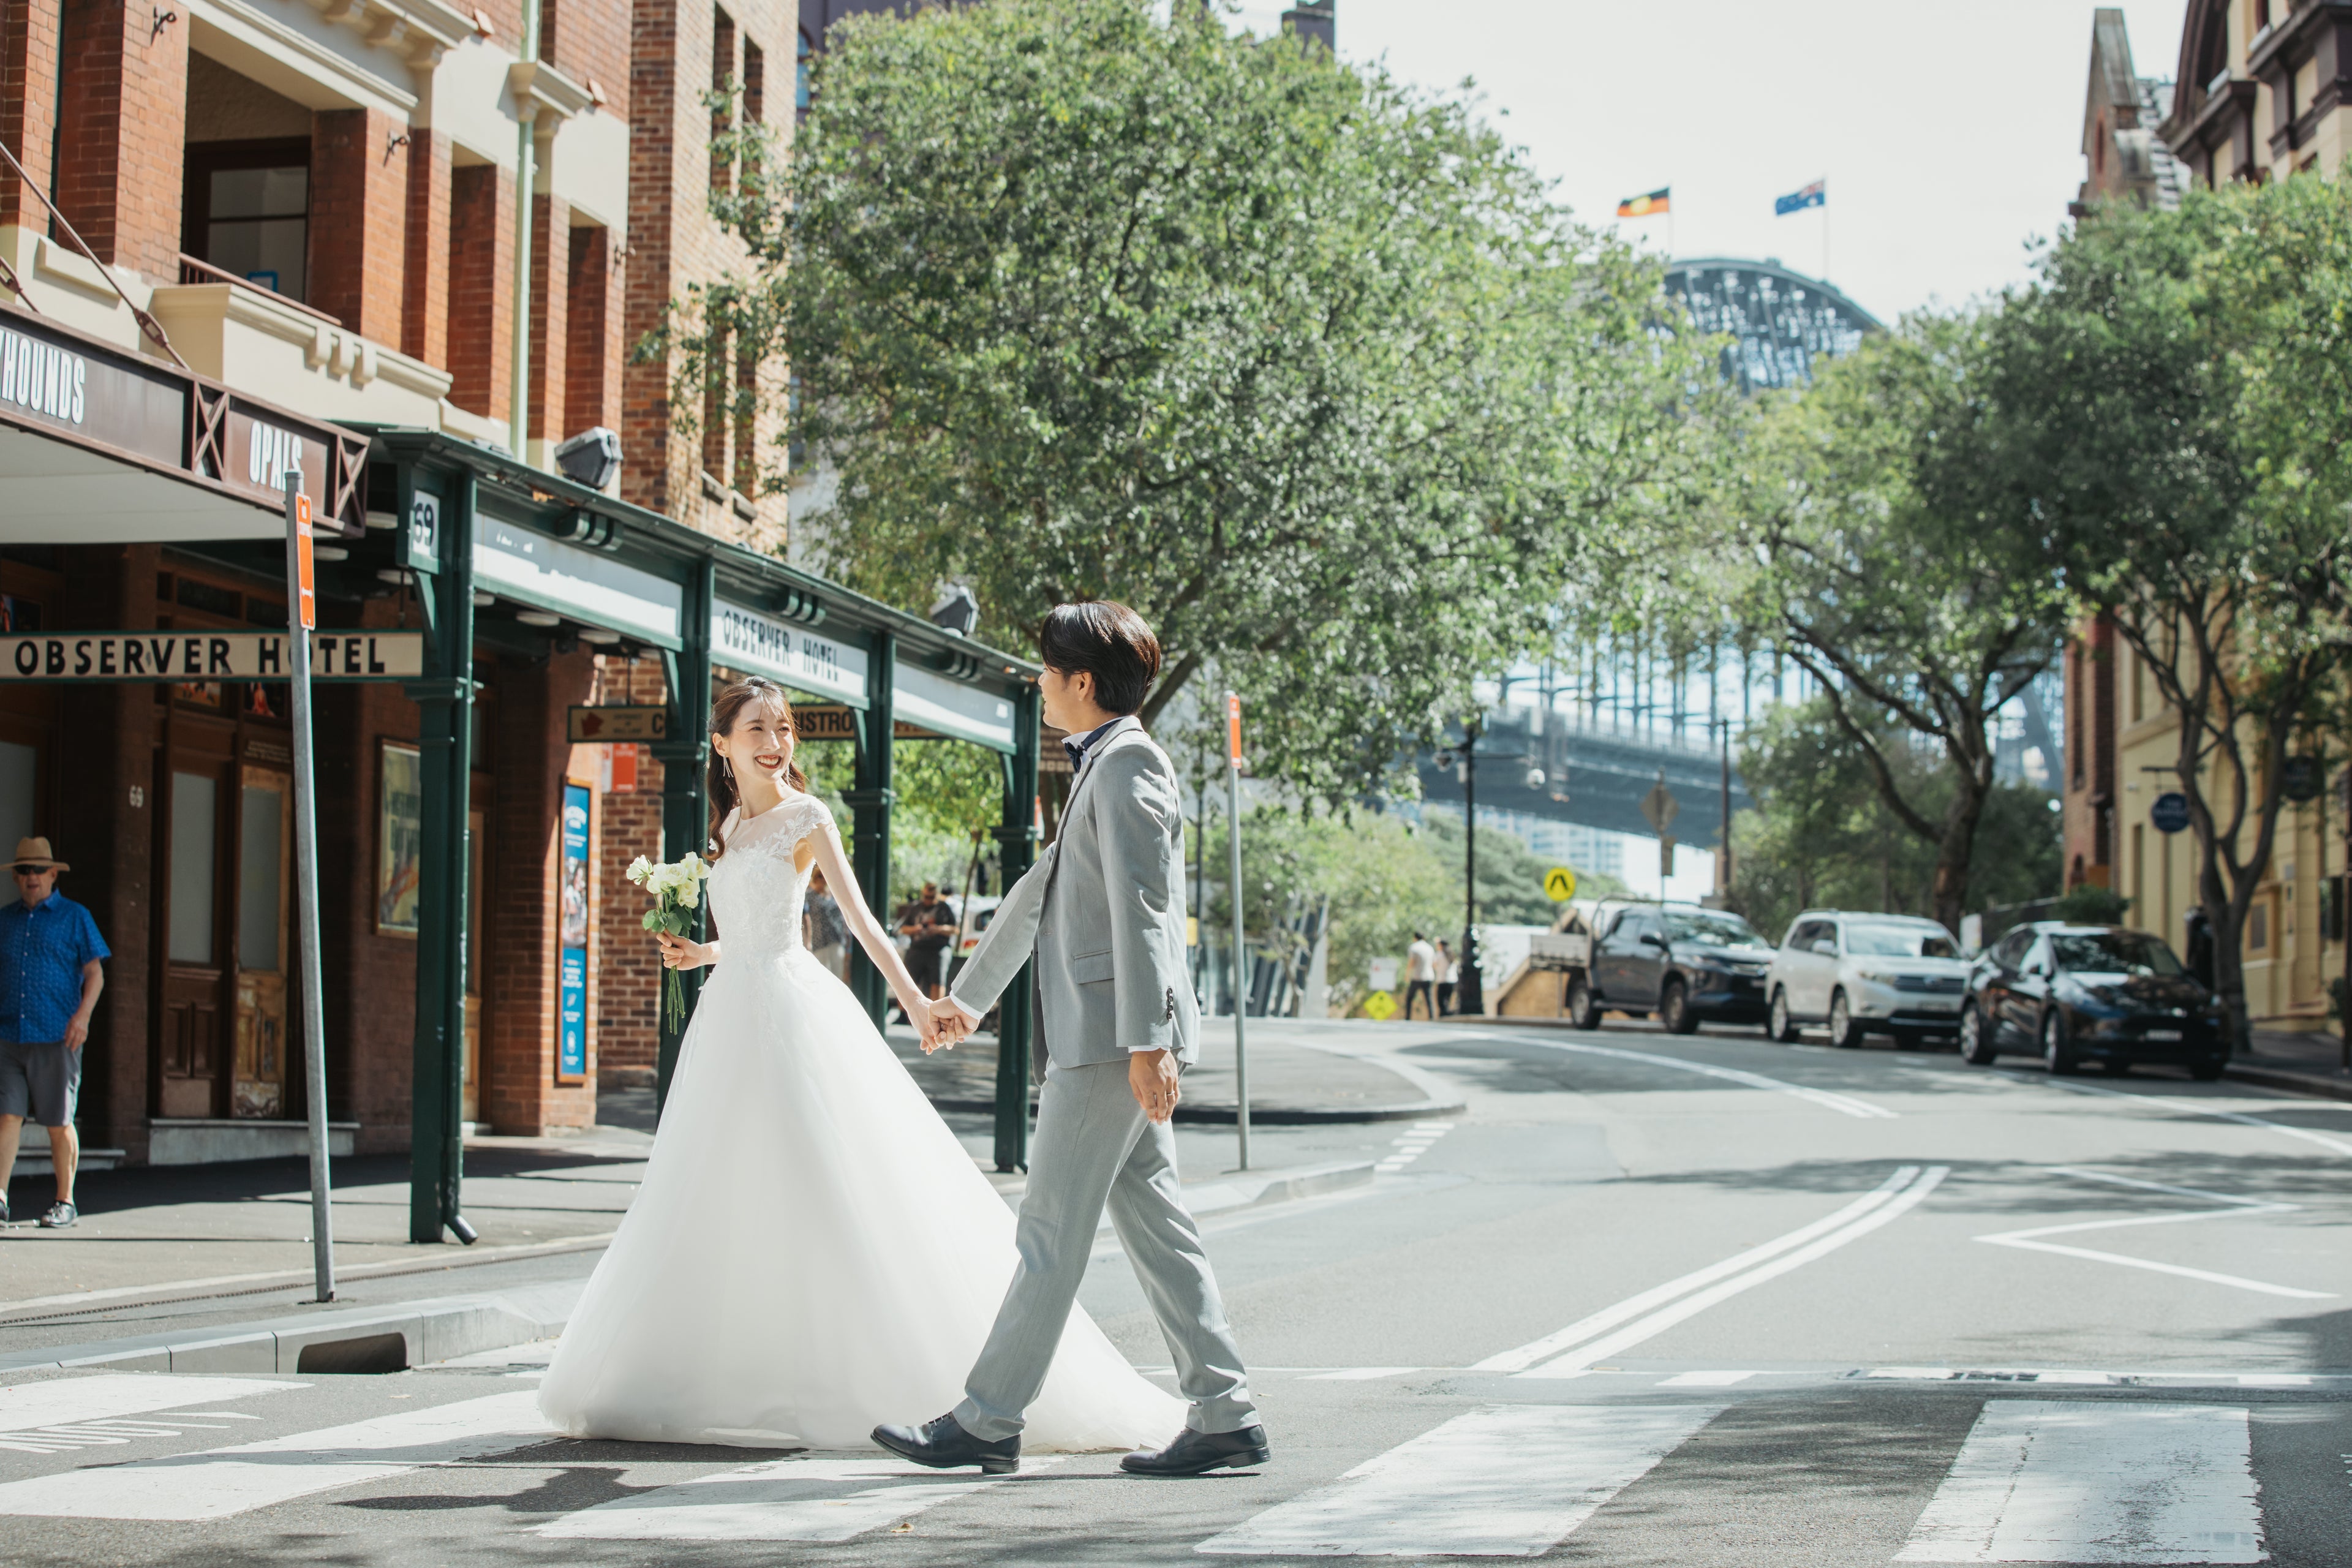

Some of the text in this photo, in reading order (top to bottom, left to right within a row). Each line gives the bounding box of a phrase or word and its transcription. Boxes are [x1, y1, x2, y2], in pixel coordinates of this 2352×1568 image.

[413, 502, 434, 547] 69
[15, 638, 385, 676] OBSERVER HTEL
[724, 611, 838, 682] OBSERVER HOTEL
[794, 711, 853, 733] ISTRO
